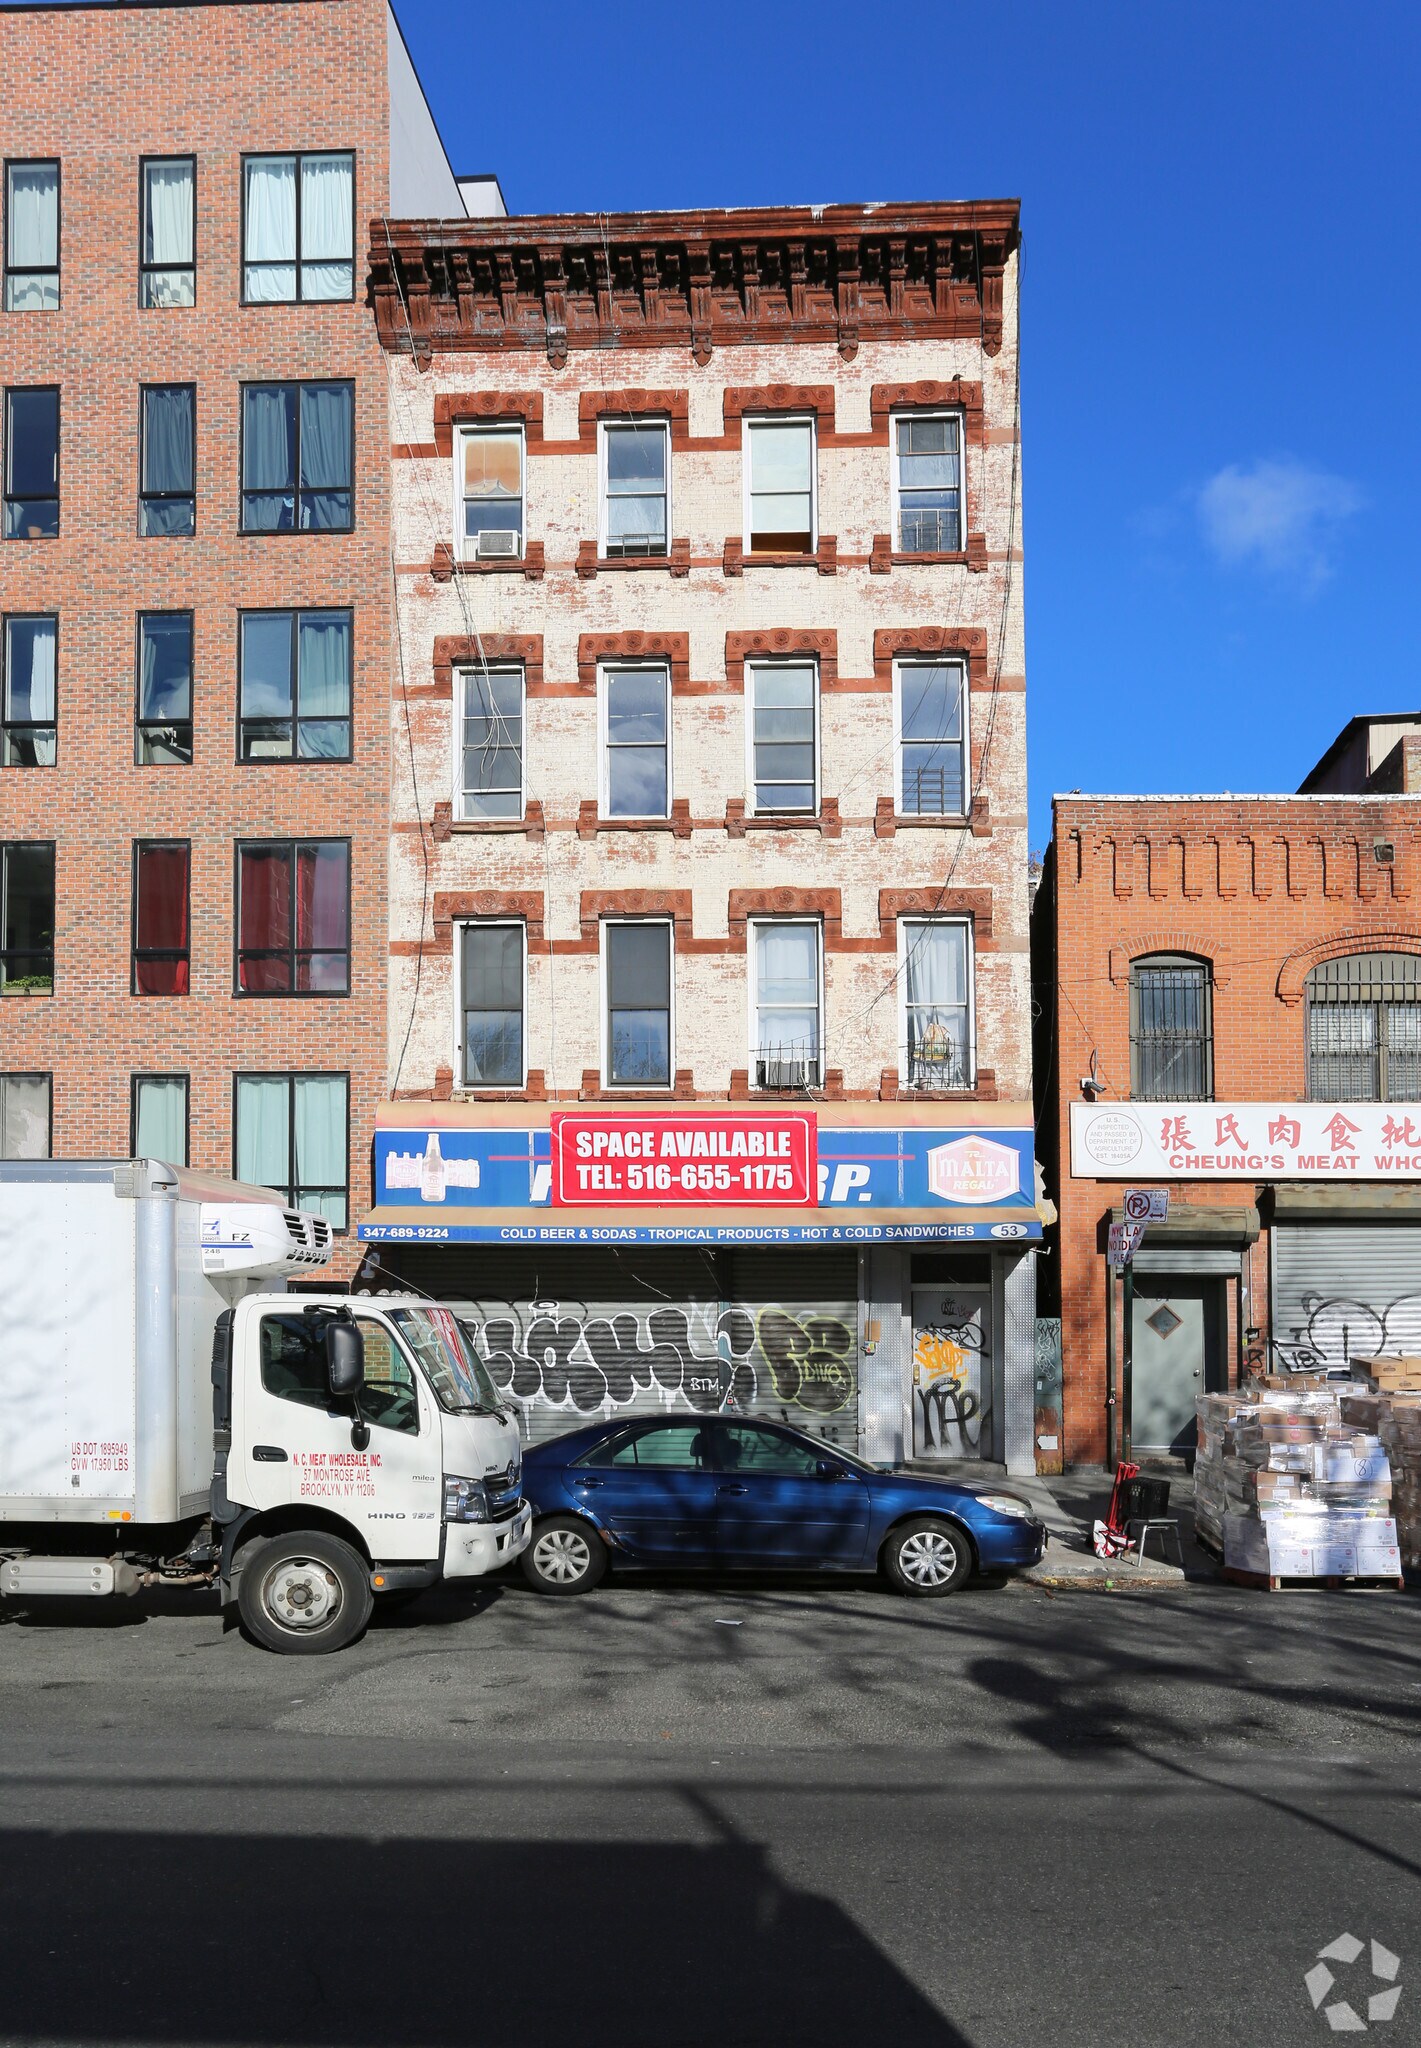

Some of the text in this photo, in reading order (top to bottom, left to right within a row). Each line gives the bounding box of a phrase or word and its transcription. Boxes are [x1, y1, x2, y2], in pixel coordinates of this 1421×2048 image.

[575, 1131, 792, 1158] SPACE AVAILABLE
[940, 1159, 1009, 1177] MALTA
[1169, 1154, 1285, 1170] CHEUNG'S
[1297, 1155, 1360, 1170] MEAT
[576, 1164, 622, 1190] TEL:
[627, 1164, 793, 1190] 516-655-1175
[953, 1180, 995, 1190] REGAL
[232, 1233, 250, 1241] FZ
[363, 1227, 449, 1238] 347-689-9224
[501, 1228, 536, 1239] COLD
[540, 1228, 576, 1239] BEER
[578, 1229, 588, 1239] &
[592, 1229, 637, 1239] SODAS
[648, 1229, 714, 1239] TROPICAL
[717, 1228, 790, 1239] PRODUCTS
[801, 1228, 828, 1239] HOT
[832, 1227, 841, 1238] &
[844, 1227, 882, 1238] COLD
[885, 1226, 975, 1237] SANDWICHES
[1000, 1225, 1018, 1236] 53
[293, 1248, 328, 1258] ZANOTTI
[71, 1442, 128, 1455] US DOT 1895949
[71, 1457, 129, 1472] GVW 17,950 LBS
[293, 1453, 382, 1468] N. C. MEAT WHOLESALE, INC.
[303, 1469, 372, 1481] 57 MONTROSE AVE.
[1359, 1459, 1366, 1477] 8
[300, 1483, 376, 1497] BROOKLYN, NY 11206
